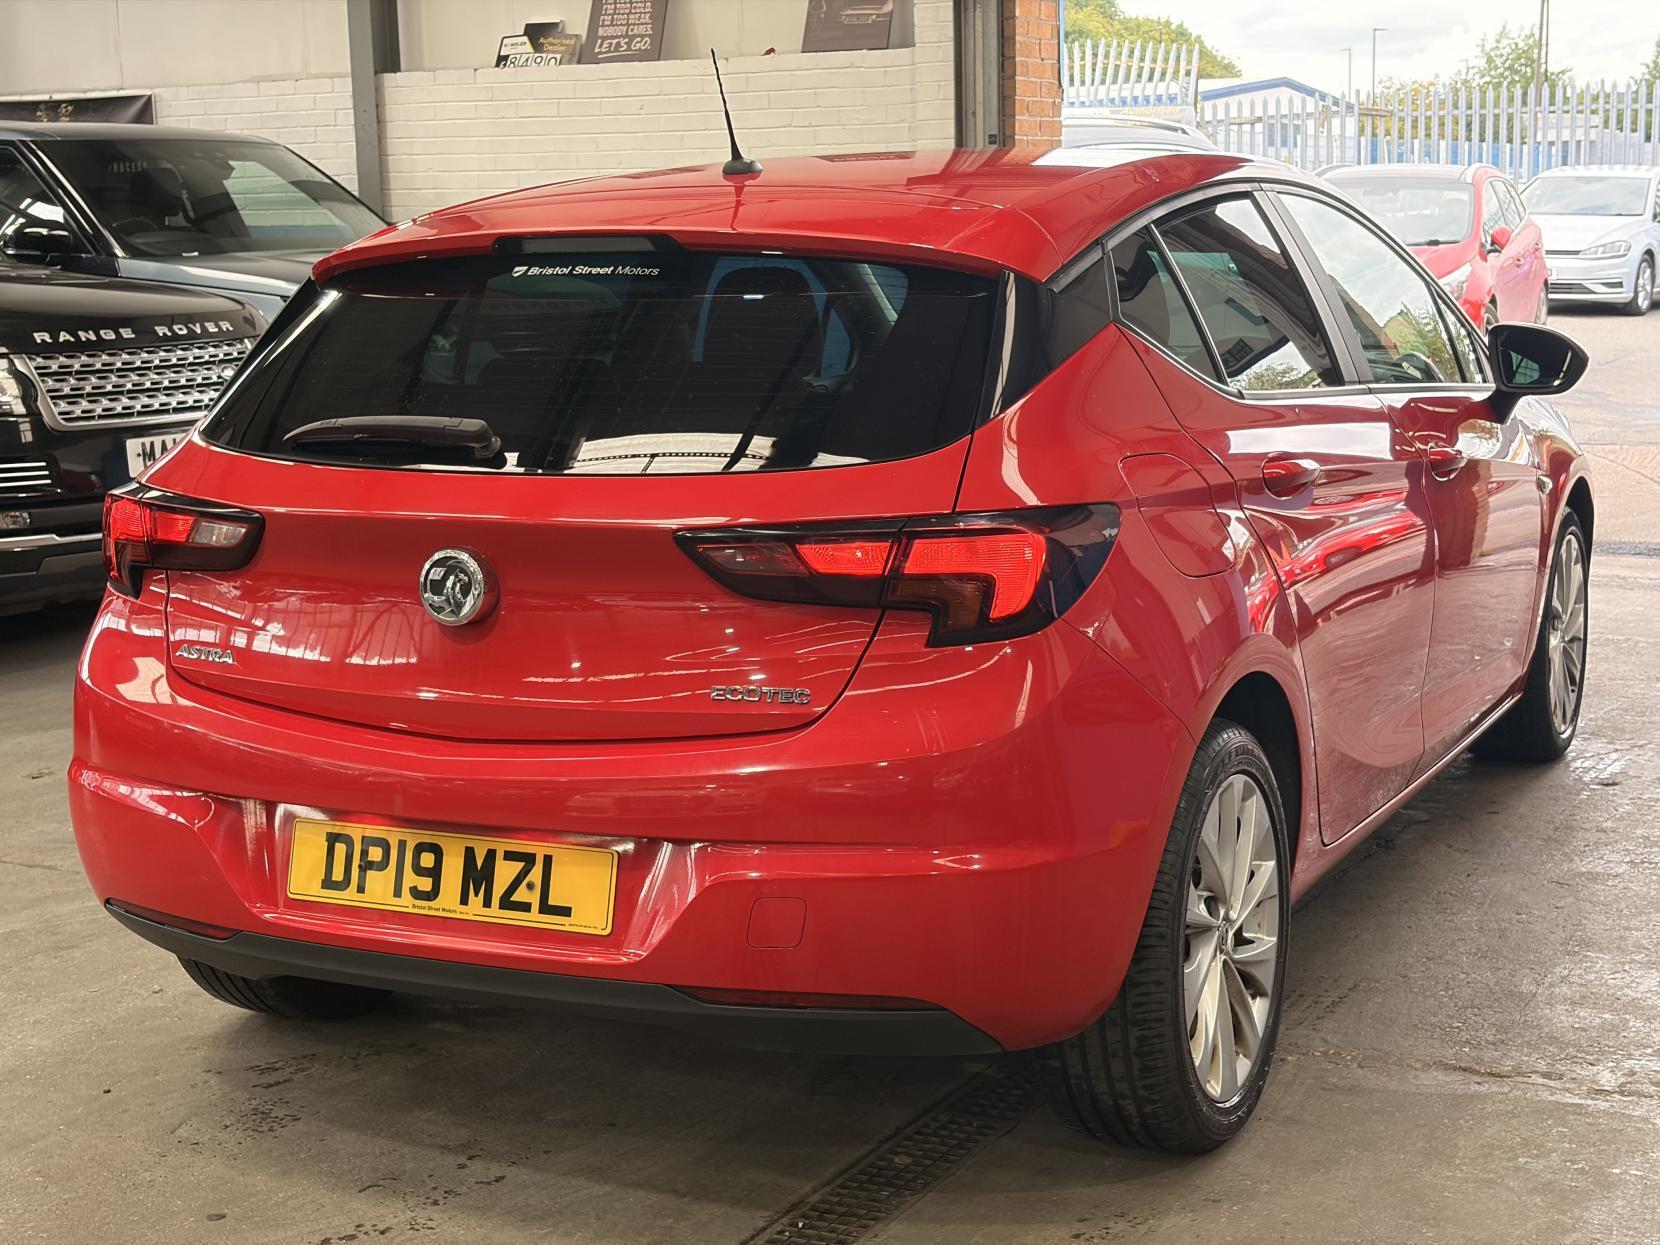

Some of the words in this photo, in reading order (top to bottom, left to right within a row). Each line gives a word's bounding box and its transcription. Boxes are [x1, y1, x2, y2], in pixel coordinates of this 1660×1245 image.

[616, 3, 630, 14] TOO
[613, 14, 628, 25] TOO
[597, 26, 628, 37] NOBODY
[594, 37, 629, 53] LET'S
[630, 36, 651, 50] GO.
[527, 265, 572, 276] Bristol
[572, 265, 614, 275] Street
[615, 265, 660, 276] Motors
[32, 327, 136, 344] RANGE
[154, 320, 234, 337] ROVER
[175, 644, 233, 664] ASTRA
[710, 685, 811, 704] ECOTEC
[320, 831, 444, 902] DP19
[459, 845, 573, 918] MZL
